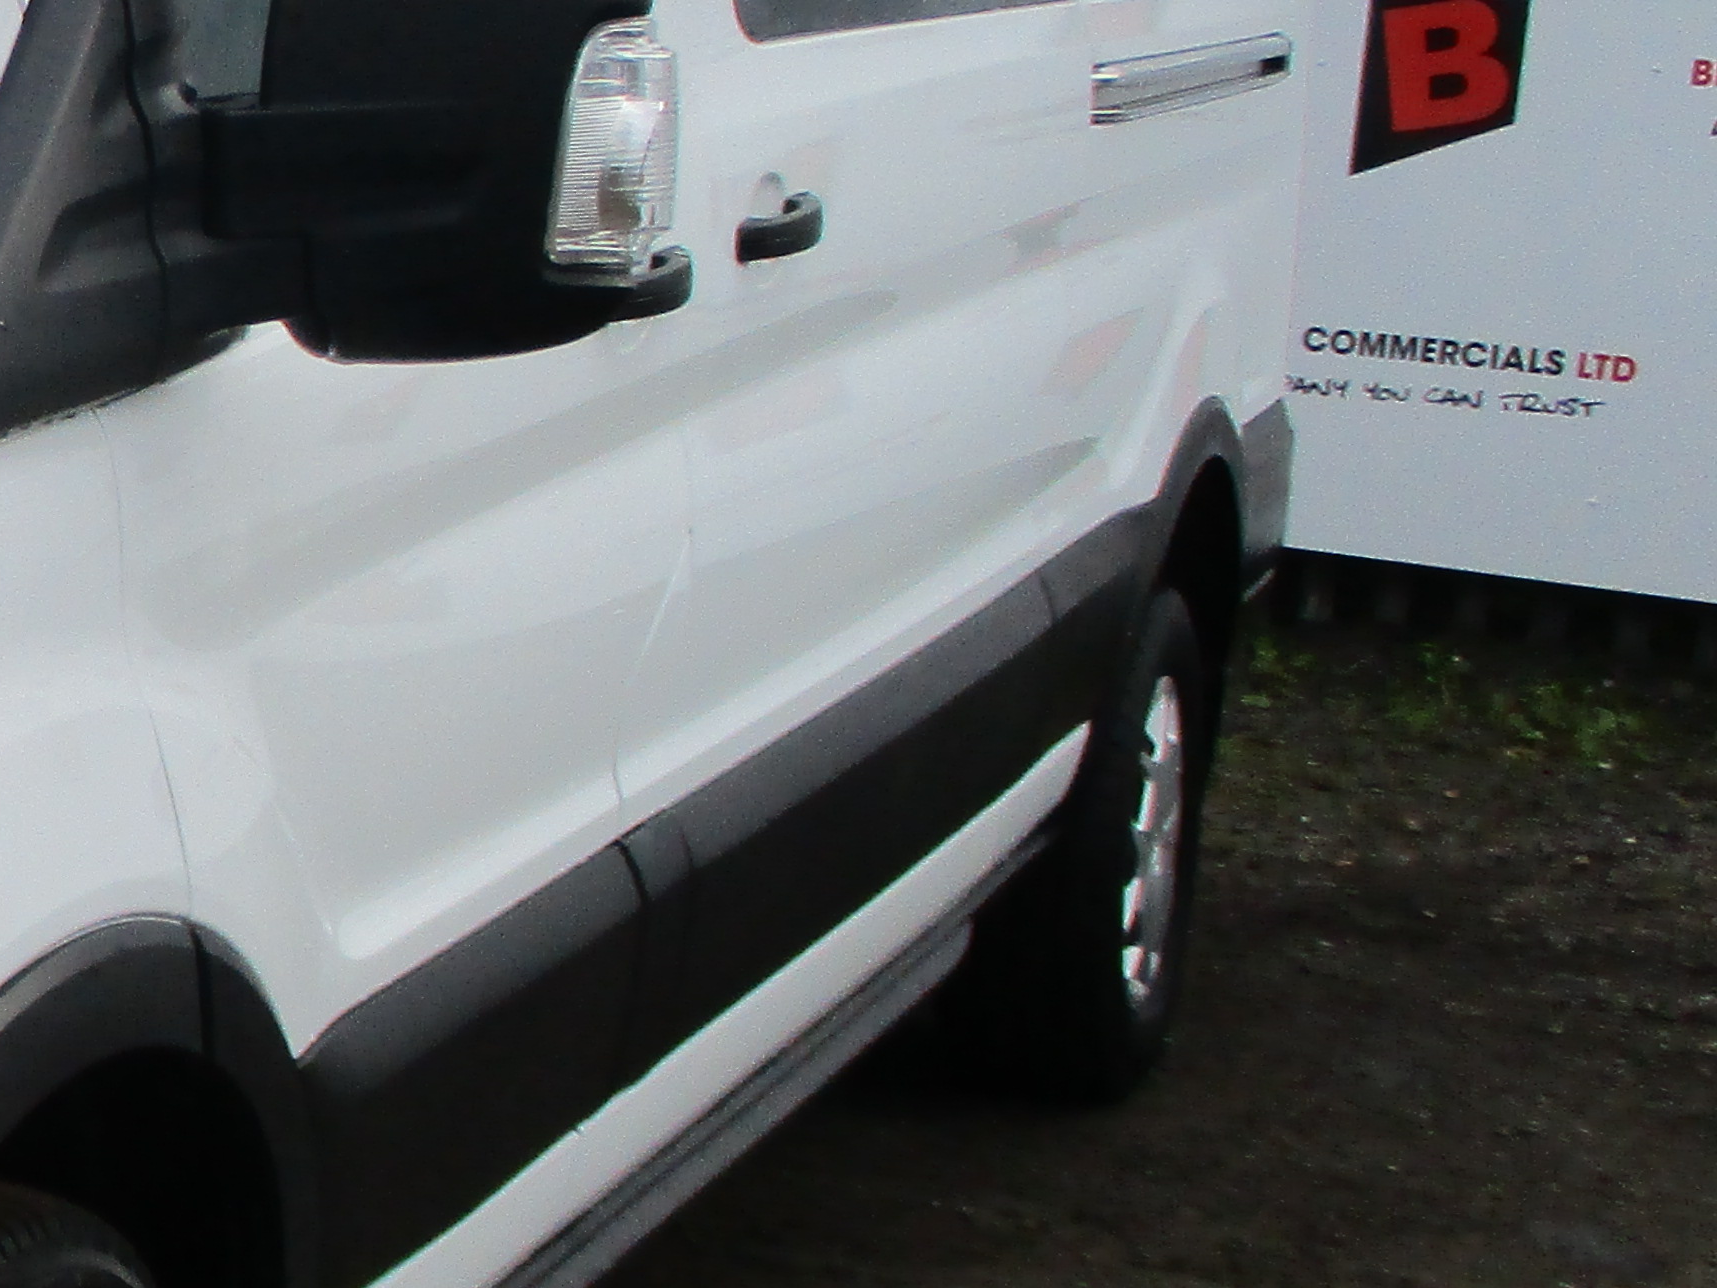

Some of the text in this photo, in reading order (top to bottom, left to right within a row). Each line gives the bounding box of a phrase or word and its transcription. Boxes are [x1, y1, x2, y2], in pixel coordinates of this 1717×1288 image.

[1691, 58, 1717, 87] B
[1302, 326, 1638, 383] COMMERCIALS LTD
[1422, 386, 1484, 409] CAN
[1498, 392, 1607, 418] TRUST
